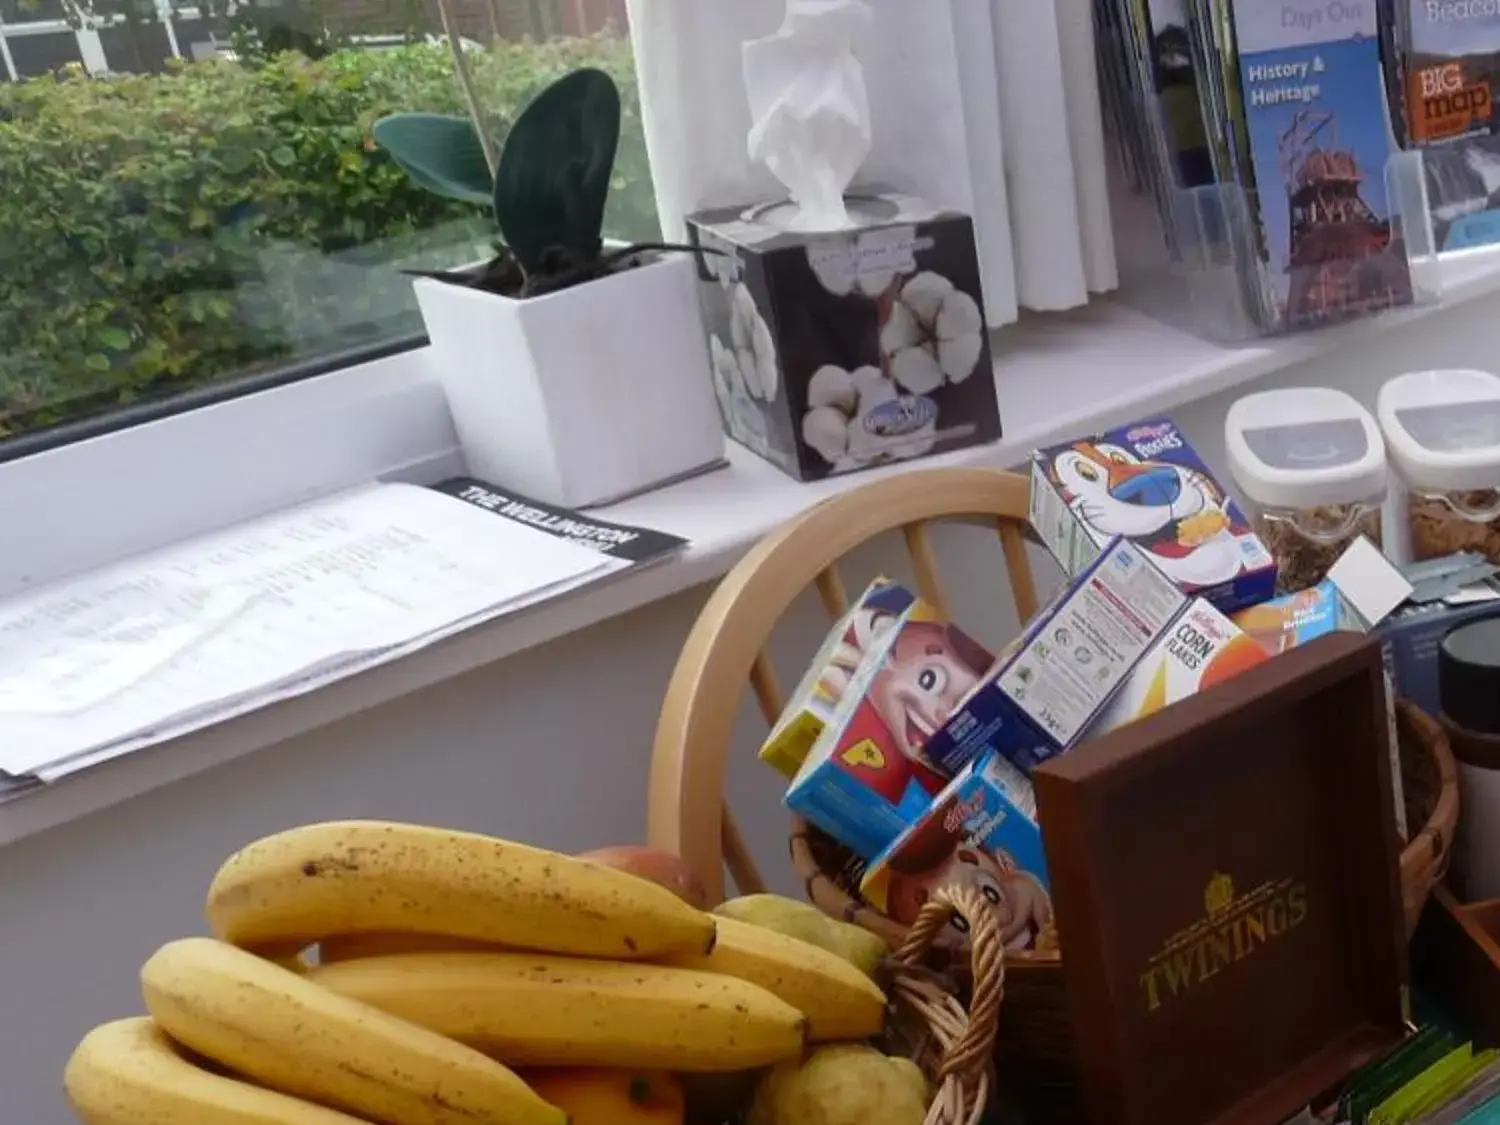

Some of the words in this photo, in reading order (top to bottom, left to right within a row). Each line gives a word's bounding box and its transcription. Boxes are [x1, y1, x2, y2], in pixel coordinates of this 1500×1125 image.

[1282, 6, 1323, 30] Days
[1328, 2, 1363, 22] Out
[1249, 61, 1309, 83] History
[1419, 63, 1464, 98] BIG
[1251, 84, 1320, 106] Heritage
[1423, 86, 1488, 120] map
[1164, 638, 1202, 671] FLAKES
[1176, 624, 1215, 660] CORN
[1140, 883, 1307, 1012] TWININGS
